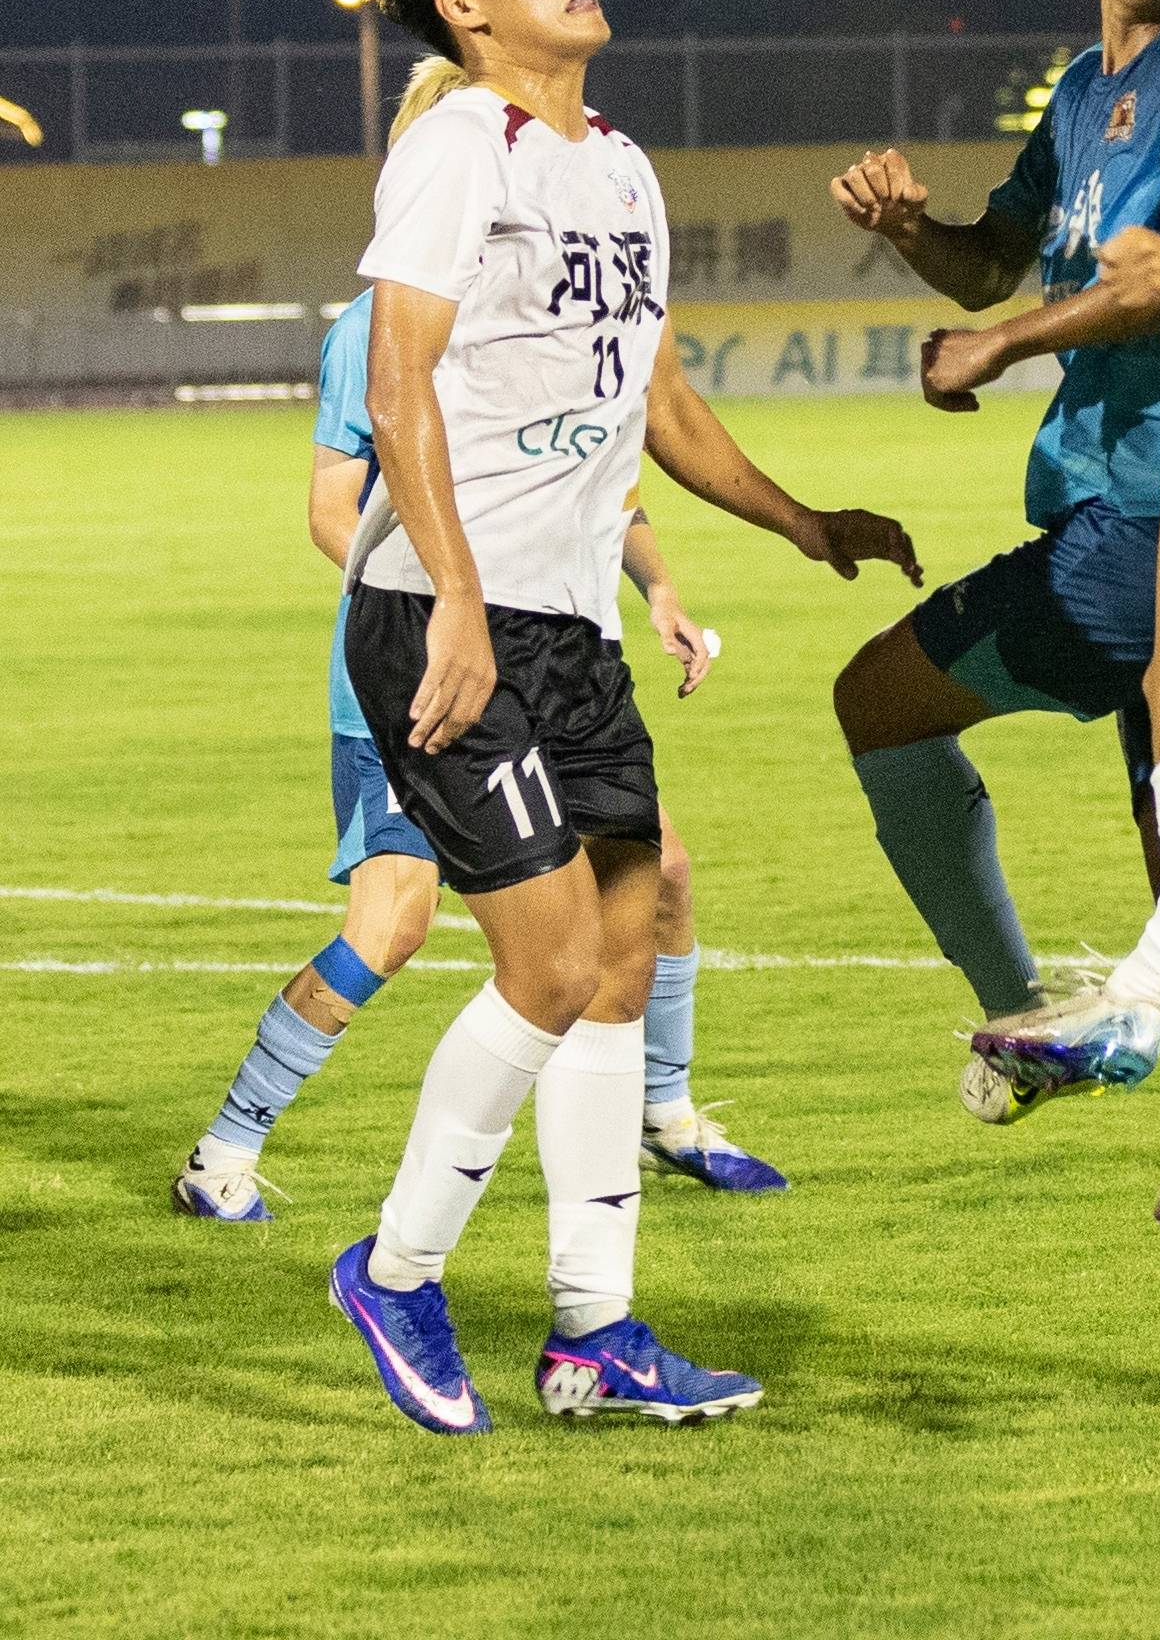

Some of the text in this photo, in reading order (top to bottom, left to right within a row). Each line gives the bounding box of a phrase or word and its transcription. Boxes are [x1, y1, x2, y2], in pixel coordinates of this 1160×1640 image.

[547, 230, 665, 326] 河源
[592, 335, 625, 398] 11
[487, 746, 562, 840] 11
